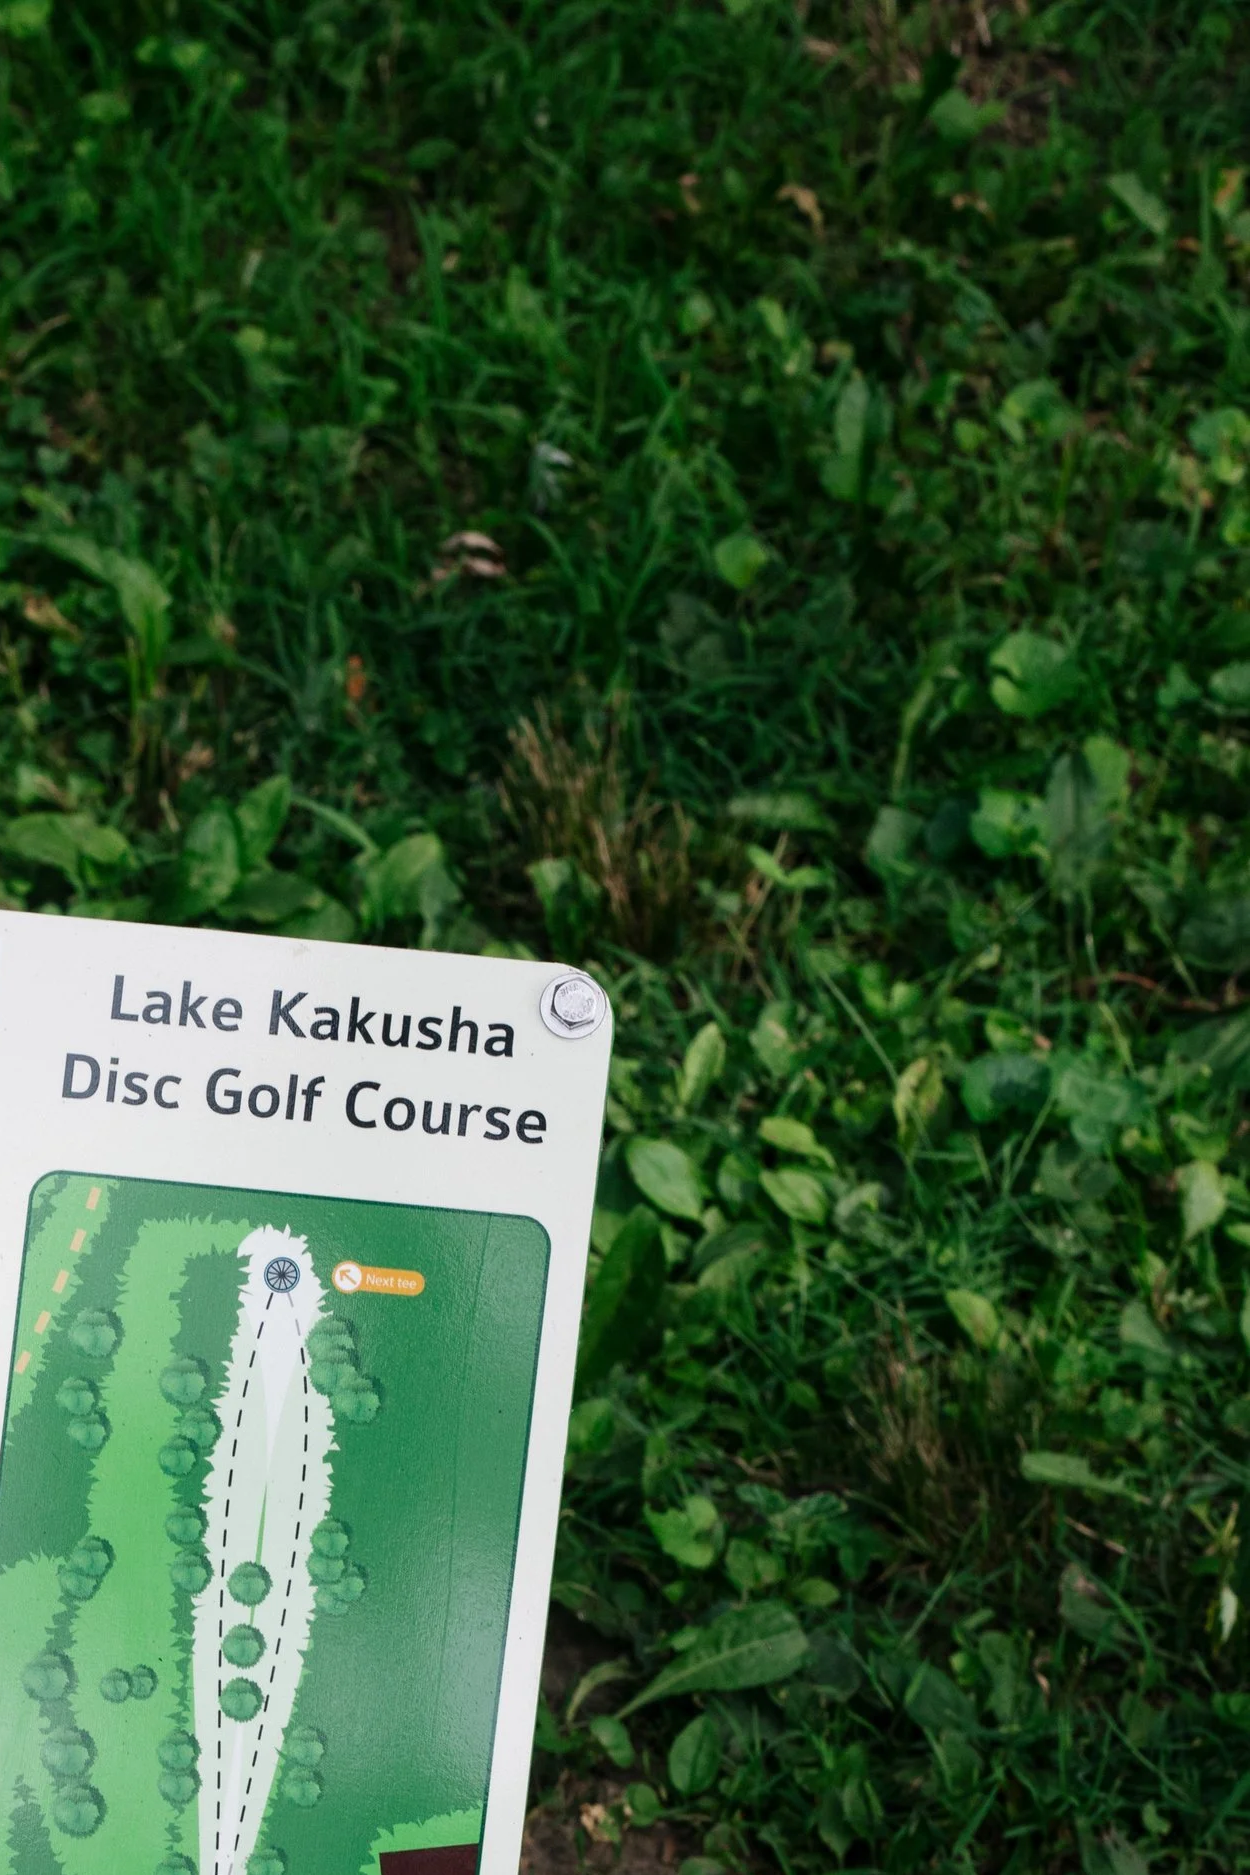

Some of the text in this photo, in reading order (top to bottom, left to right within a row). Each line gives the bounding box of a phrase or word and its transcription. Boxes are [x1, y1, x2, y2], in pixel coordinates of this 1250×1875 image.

[110, 974, 243, 1032] Lake
[268, 989, 515, 1058] Kakusha
[61, 1052, 548, 1144] Disc Golf Course
[366, 1273, 417, 1289] Next tee
